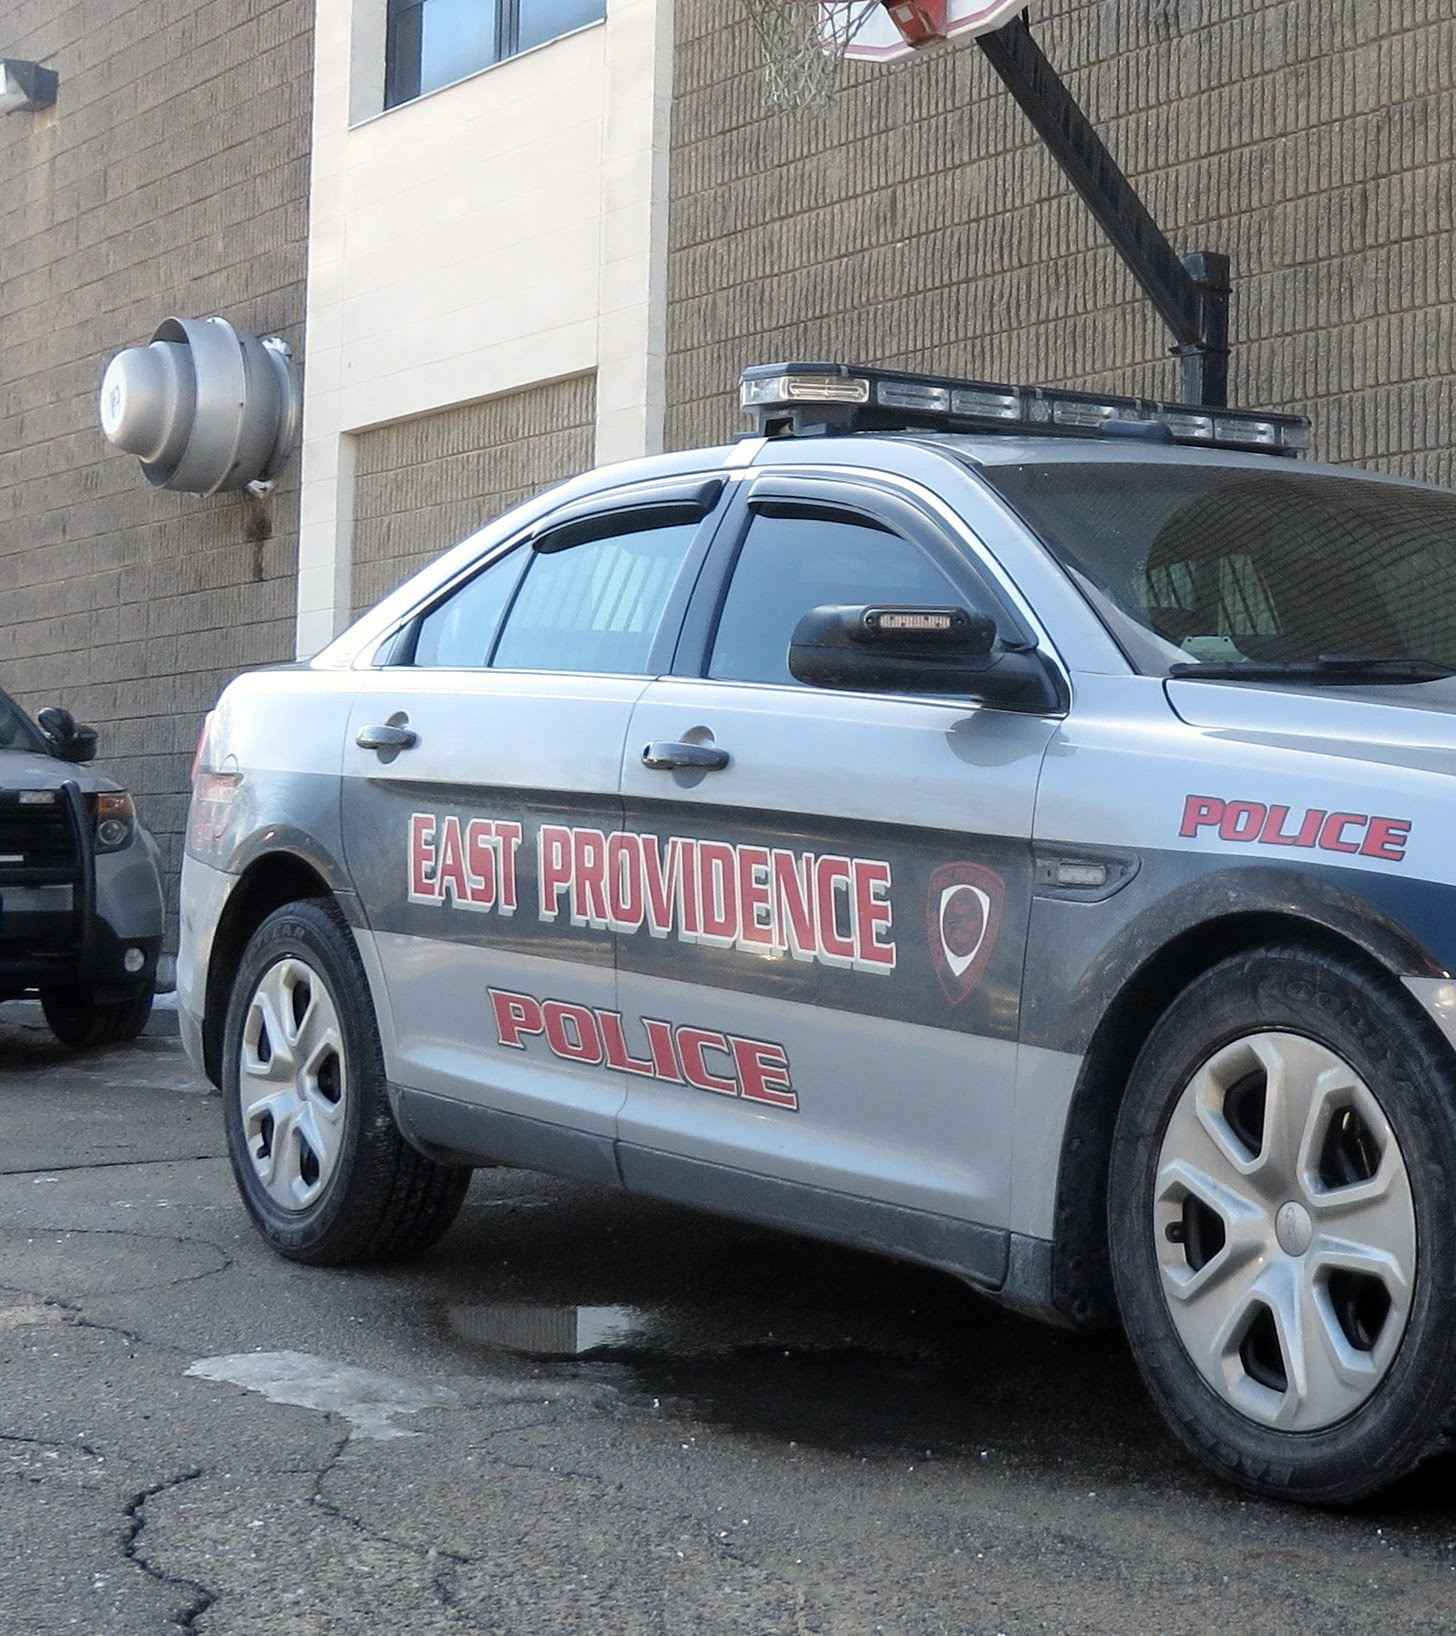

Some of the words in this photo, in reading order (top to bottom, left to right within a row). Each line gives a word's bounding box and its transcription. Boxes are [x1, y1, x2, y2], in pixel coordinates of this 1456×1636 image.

[1179, 794, 1412, 861] POLICE
[408, 813, 522, 916] EAST
[538, 824, 896, 975] PROVIDENCE
[487, 986, 799, 1112] POLICE
